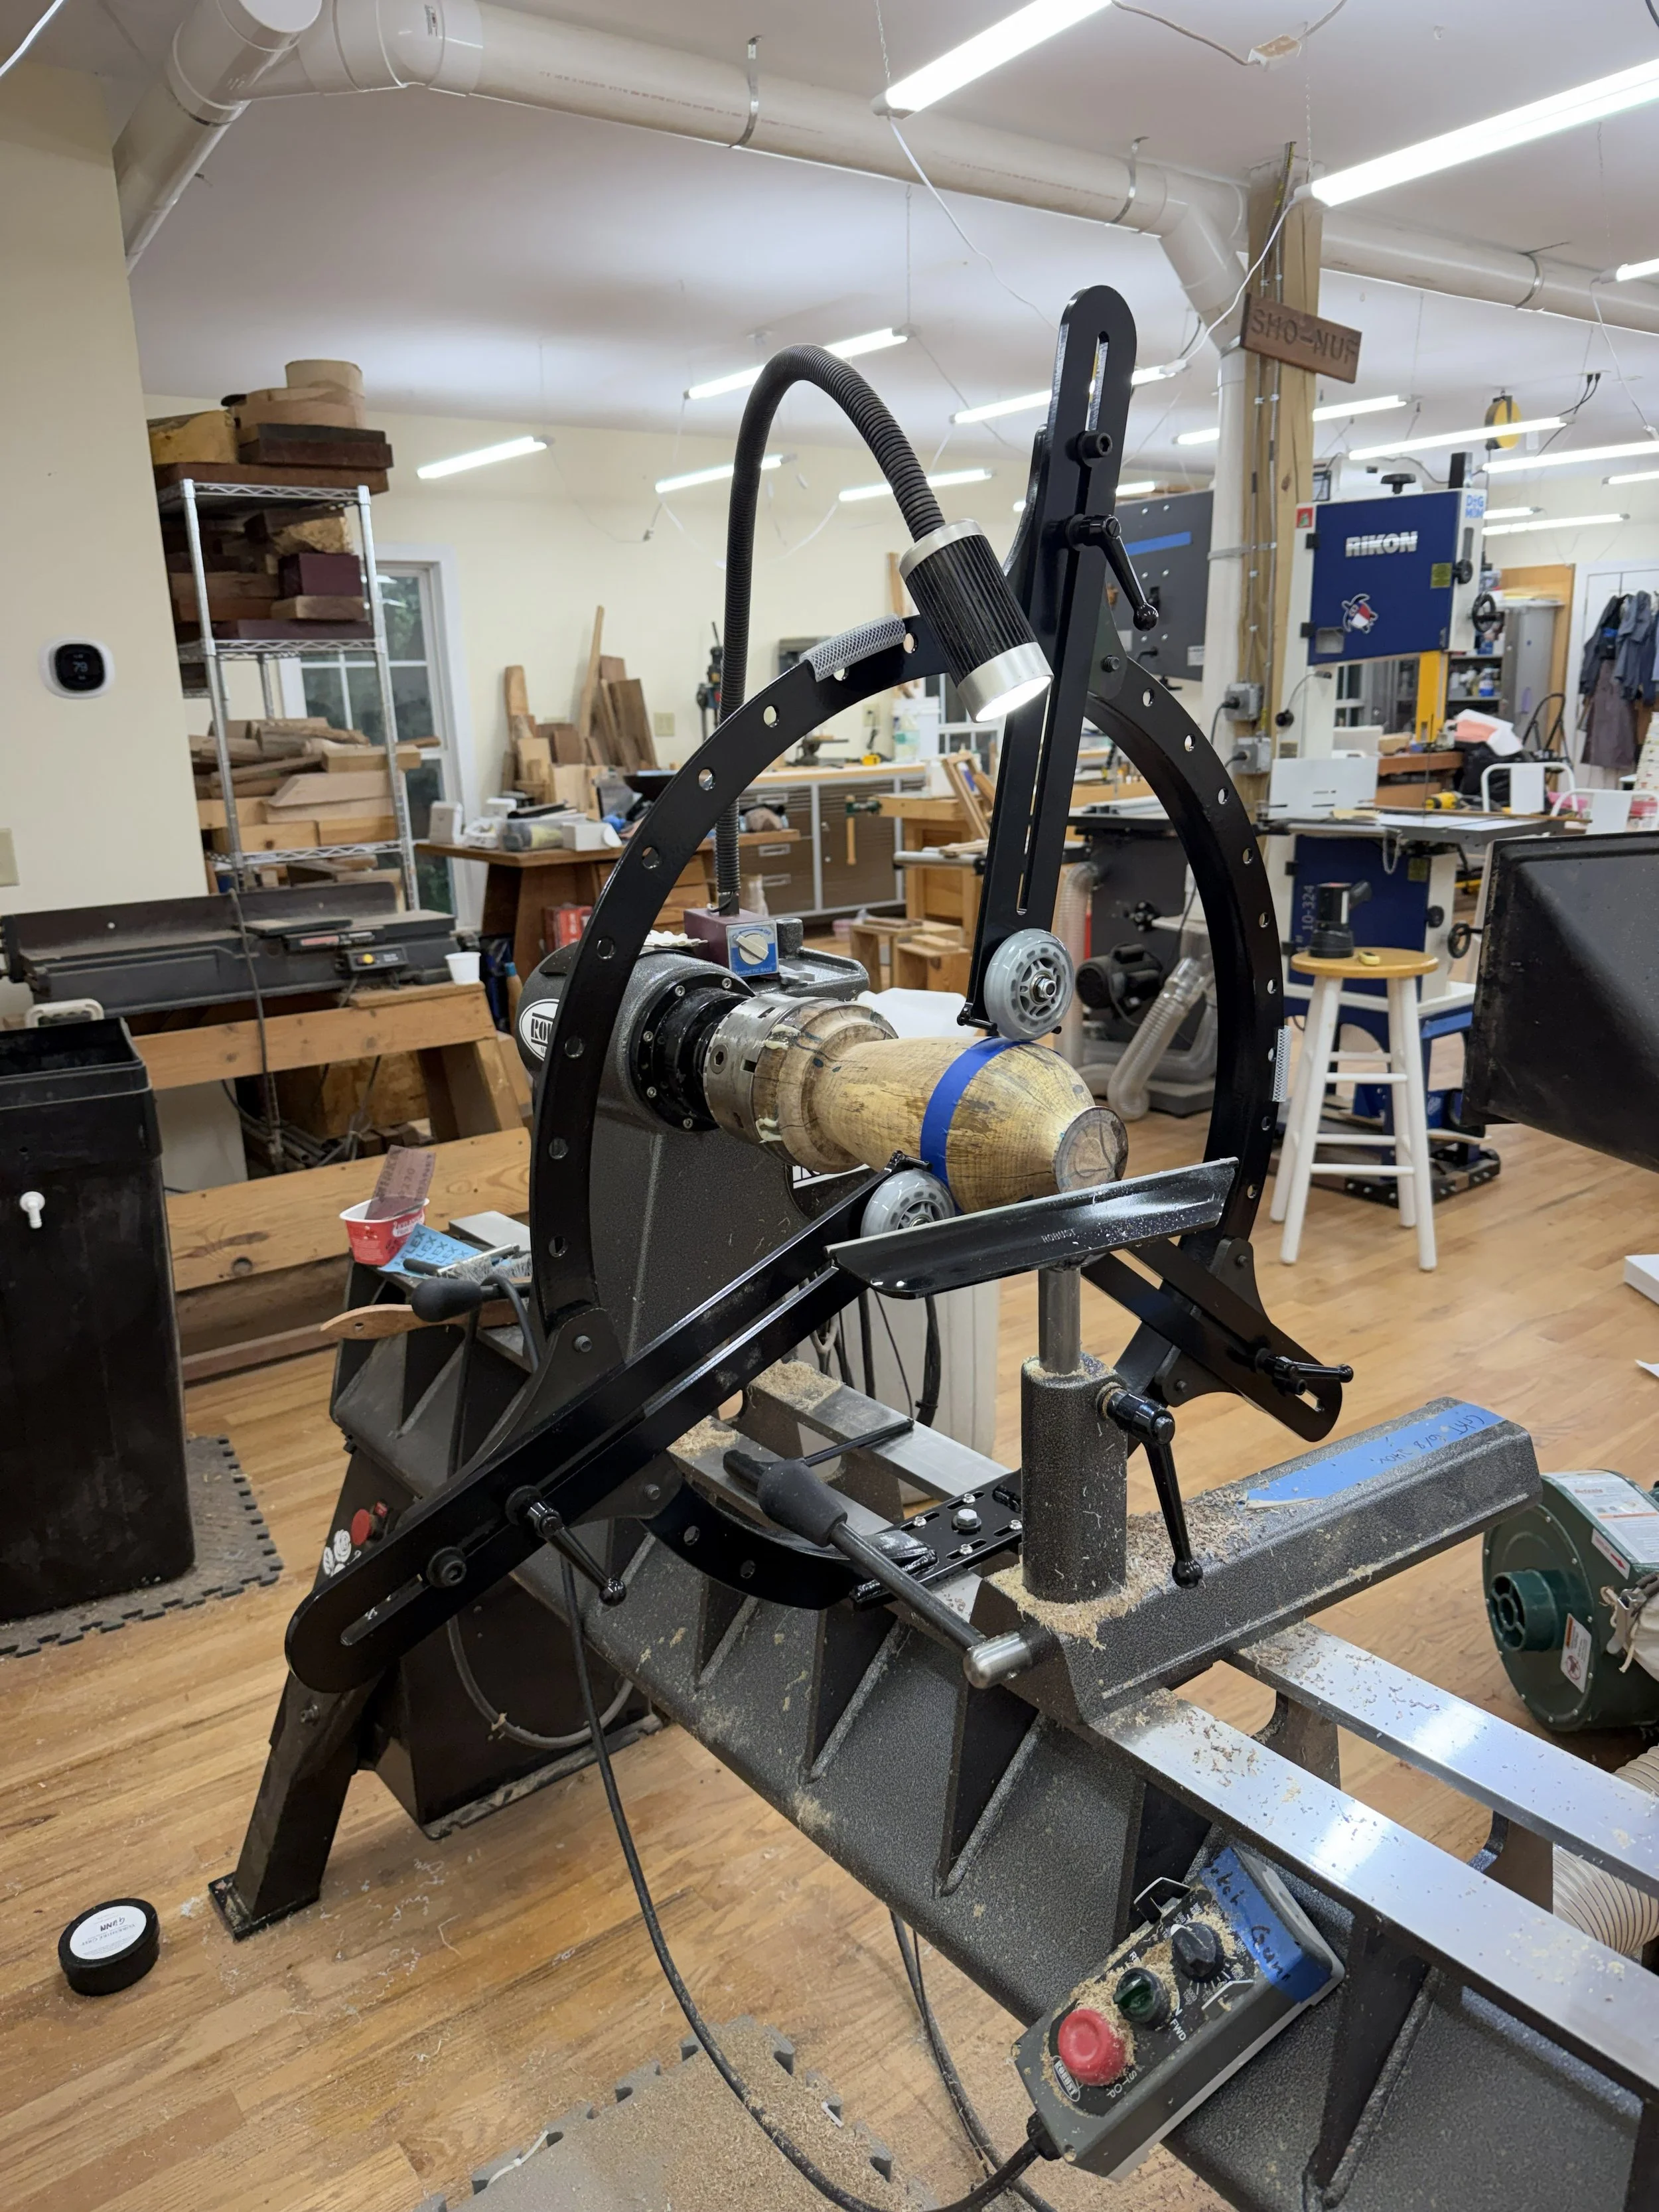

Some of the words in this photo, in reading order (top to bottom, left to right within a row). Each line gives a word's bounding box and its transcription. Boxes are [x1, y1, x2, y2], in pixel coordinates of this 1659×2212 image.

[1251, 308, 1359, 364] SHO-NUF
[1345, 530, 1418, 557] RIKON
[1301, 885, 1316, 930] 10-324
[1041, 1227, 1076, 1243] ROBUST
[1169, 2018, 1187, 2042] FWD
[1054, 2059, 1078, 2098] ROBUST
[1106, 2069, 1138, 2099] STOP
